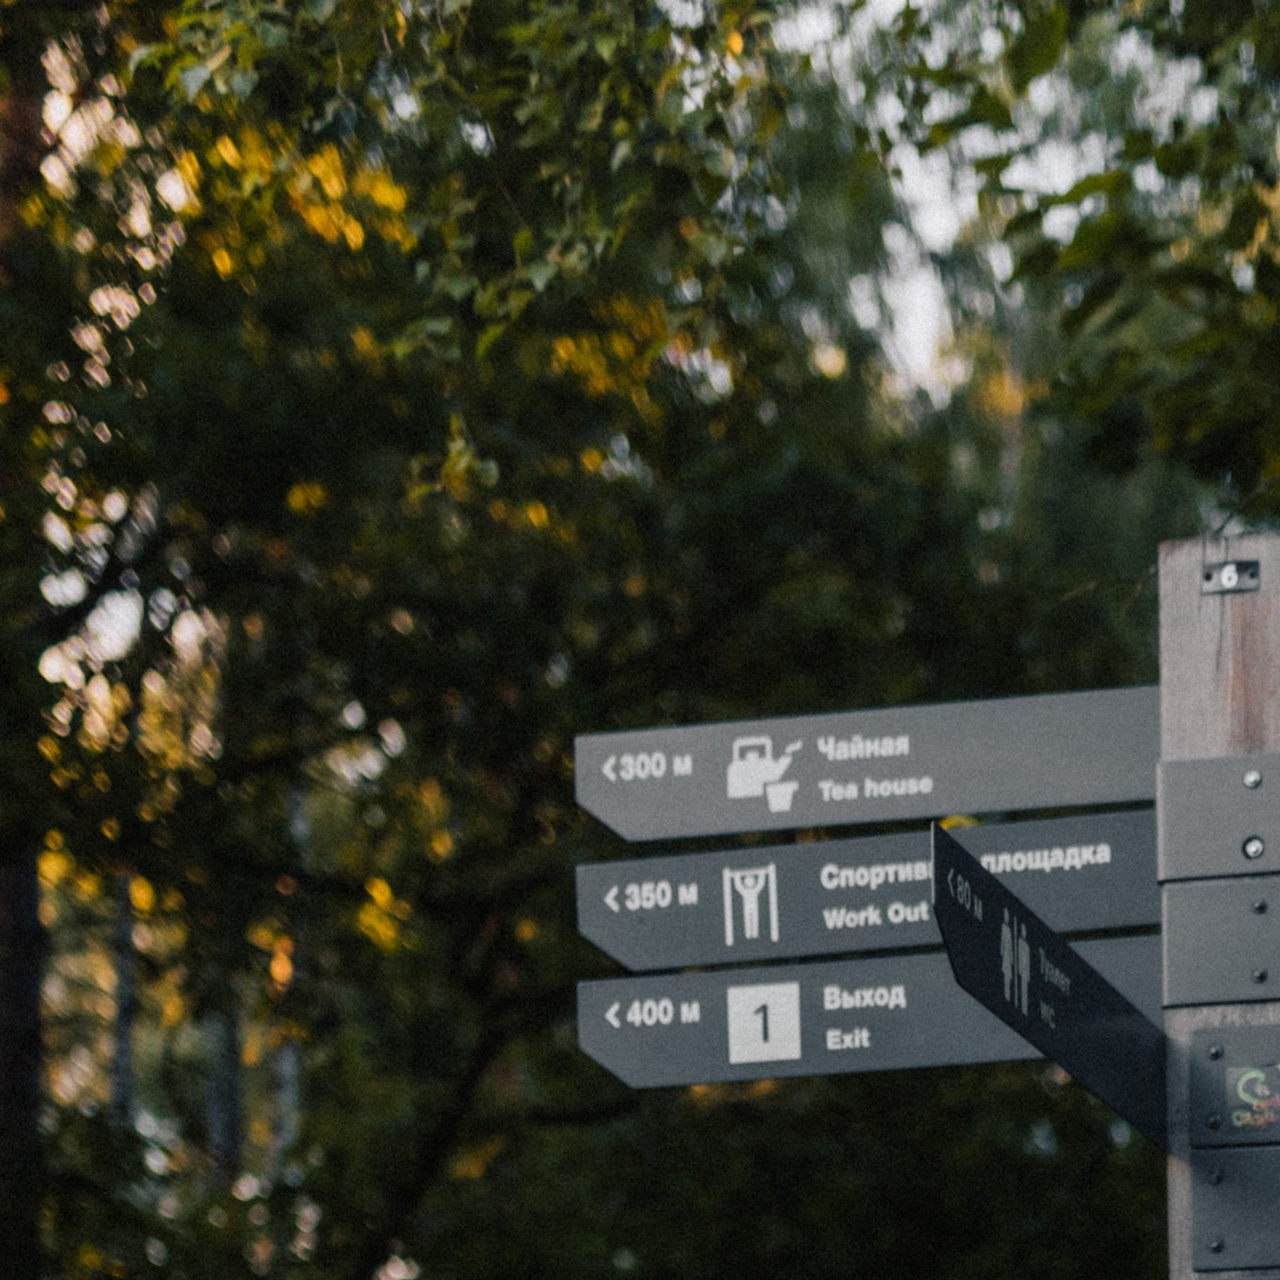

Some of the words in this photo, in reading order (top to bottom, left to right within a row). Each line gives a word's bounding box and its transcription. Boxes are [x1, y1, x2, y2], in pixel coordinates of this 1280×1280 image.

[816, 734, 910, 762] Чайная
[619, 751, 667, 782] 300
[672, 753, 694, 777] м
[817, 779, 859, 802] Tea
[863, 775, 934, 799] house
[979, 842, 1113, 874] площадка
[624, 879, 673, 912] 350
[678, 882, 699, 907] м
[821, 905, 882, 931] Work
[887, 900, 930, 925] Out
[625, 997, 675, 1028] 400
[680, 1000, 701, 1024] м
[823, 984, 908, 1011] Выход
[753, 1003, 769, 1043] 1
[825, 1027, 871, 1051] Exit
